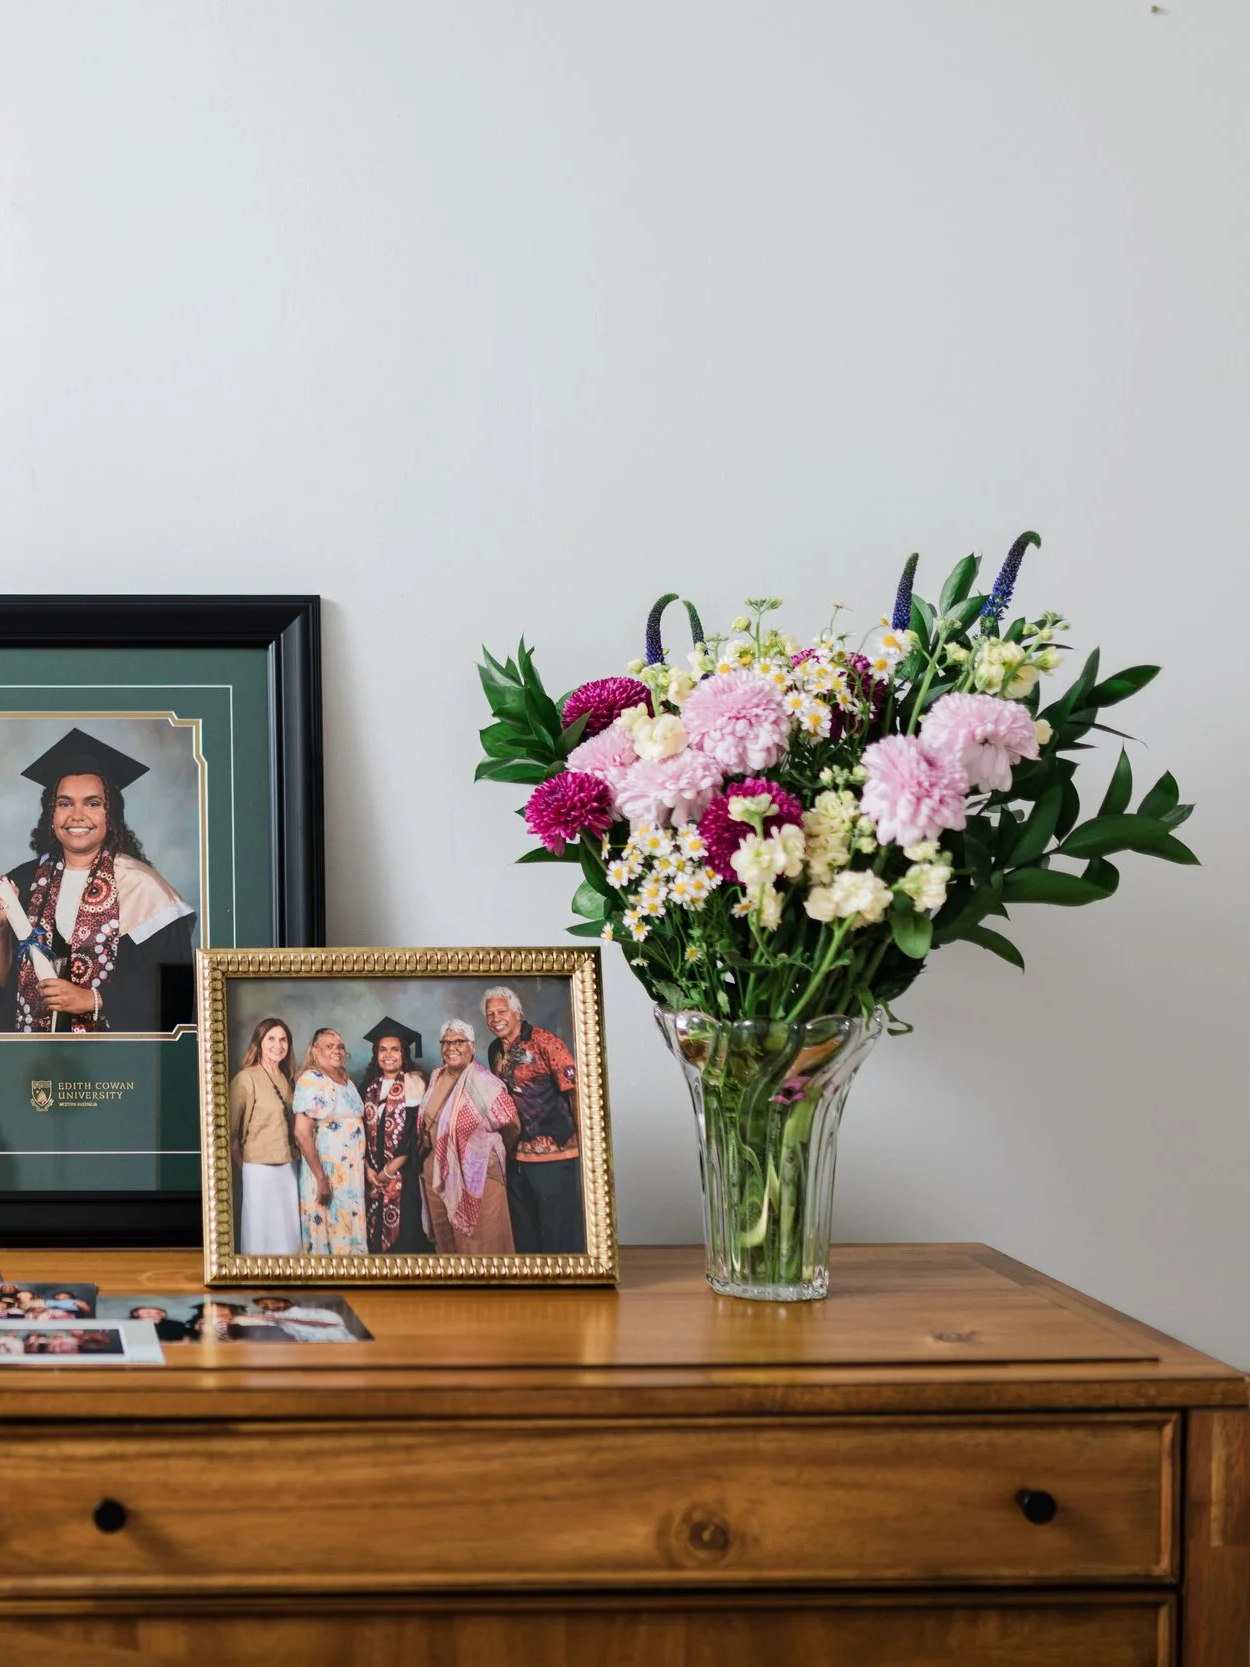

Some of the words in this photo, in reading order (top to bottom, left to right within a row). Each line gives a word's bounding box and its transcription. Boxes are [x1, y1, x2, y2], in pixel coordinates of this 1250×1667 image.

[58, 1082, 91, 1090] EDITH
[95, 1082, 134, 1090] COWAN
[58, 1091, 123, 1100] UNIVERSITY
